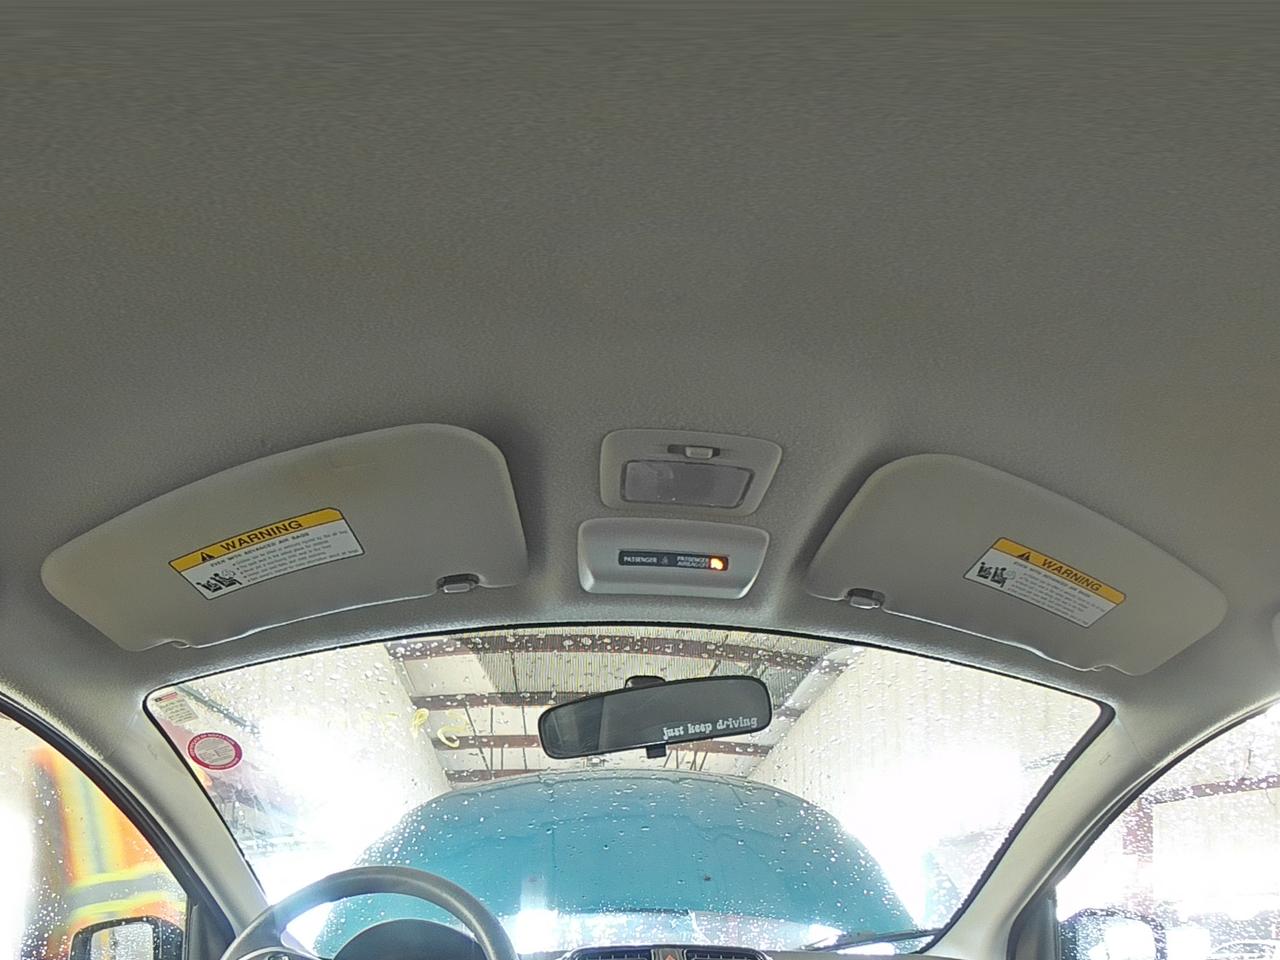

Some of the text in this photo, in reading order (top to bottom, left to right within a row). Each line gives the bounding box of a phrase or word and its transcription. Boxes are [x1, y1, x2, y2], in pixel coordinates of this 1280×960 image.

[220, 520, 303, 551] WARNING
[1041, 558, 1102, 592] WARNING
[688, 722, 712, 734] keep
[717, 717, 758, 730] driving
